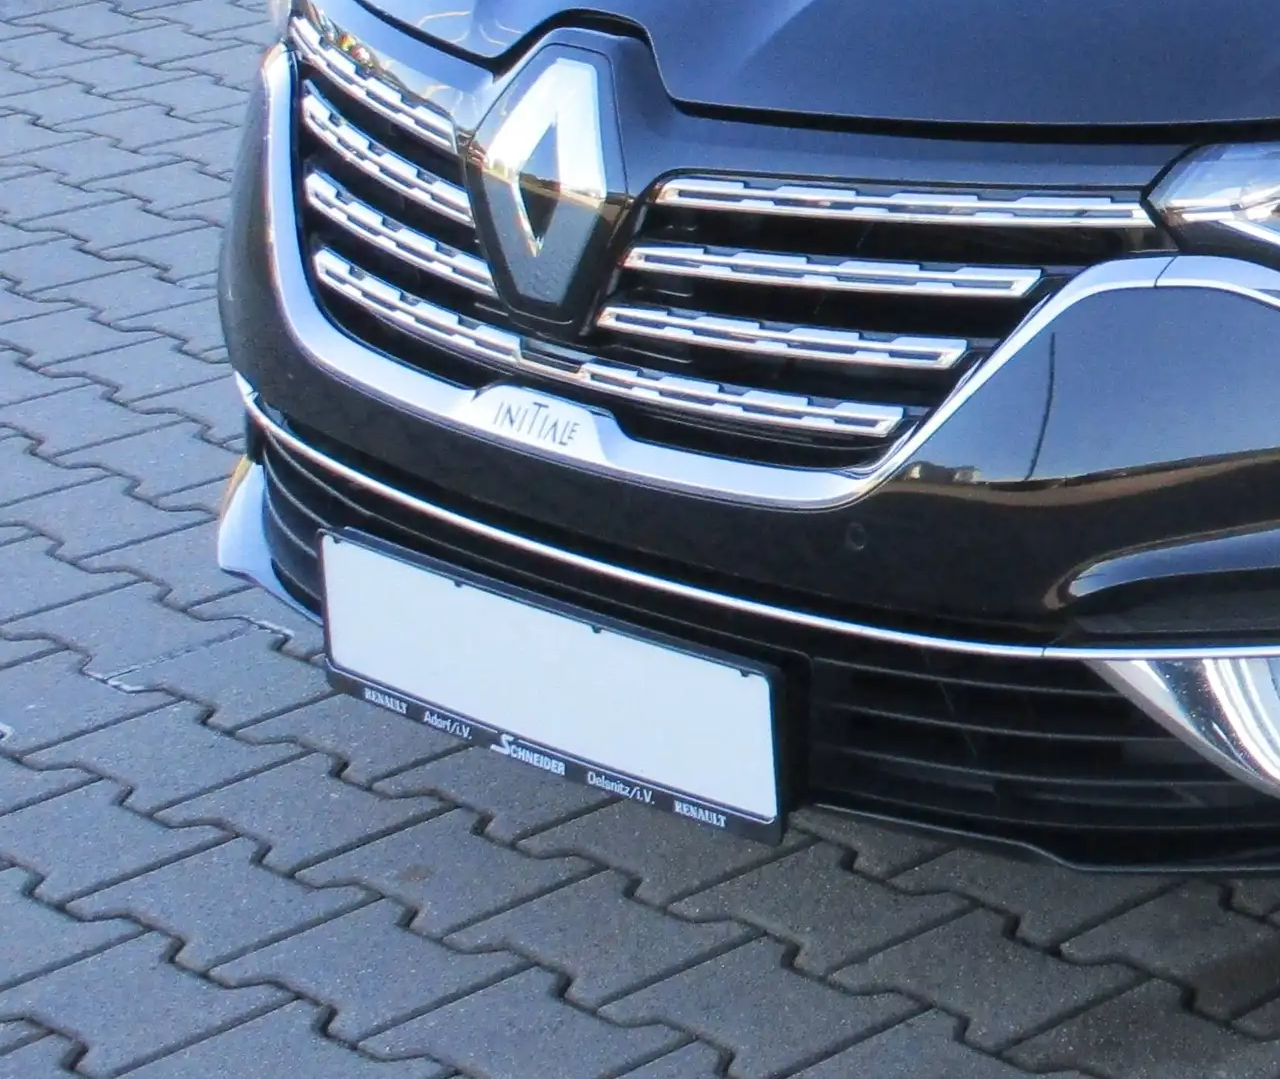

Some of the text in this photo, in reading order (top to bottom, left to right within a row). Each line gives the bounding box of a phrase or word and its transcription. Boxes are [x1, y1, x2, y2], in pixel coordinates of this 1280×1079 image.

[493, 401, 580, 446] INITIALE
[364, 687, 408, 714] RENAULT
[490, 733, 566, 776] SCHNEIDER
[674, 800, 727, 828] RENAULT
